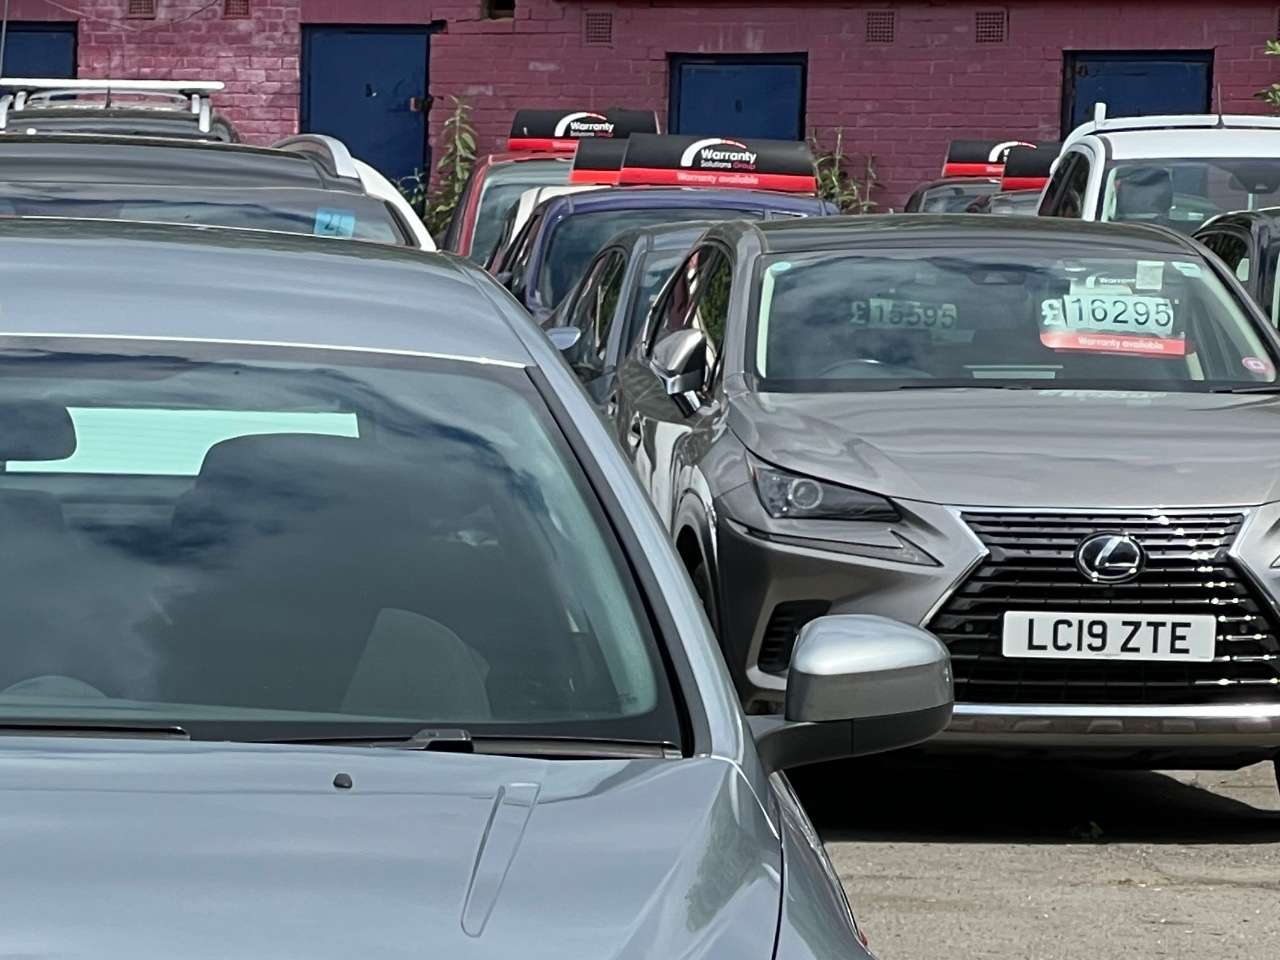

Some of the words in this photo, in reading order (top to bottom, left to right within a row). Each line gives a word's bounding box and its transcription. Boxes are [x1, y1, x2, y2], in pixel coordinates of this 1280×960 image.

[570, 122, 614, 133] Warranty
[701, 149, 757, 164] Warranty
[701, 160, 732, 169] Solutions
[677, 172, 717, 184] Warranty
[719, 174, 759, 185] available
[1041, 298, 1172, 328] £16295
[1078, 336, 1121, 348] Warranty
[1122, 339, 1164, 351] available
[1027, 618, 1108, 652] LC19
[1120, 620, 1192, 654] ZTE
